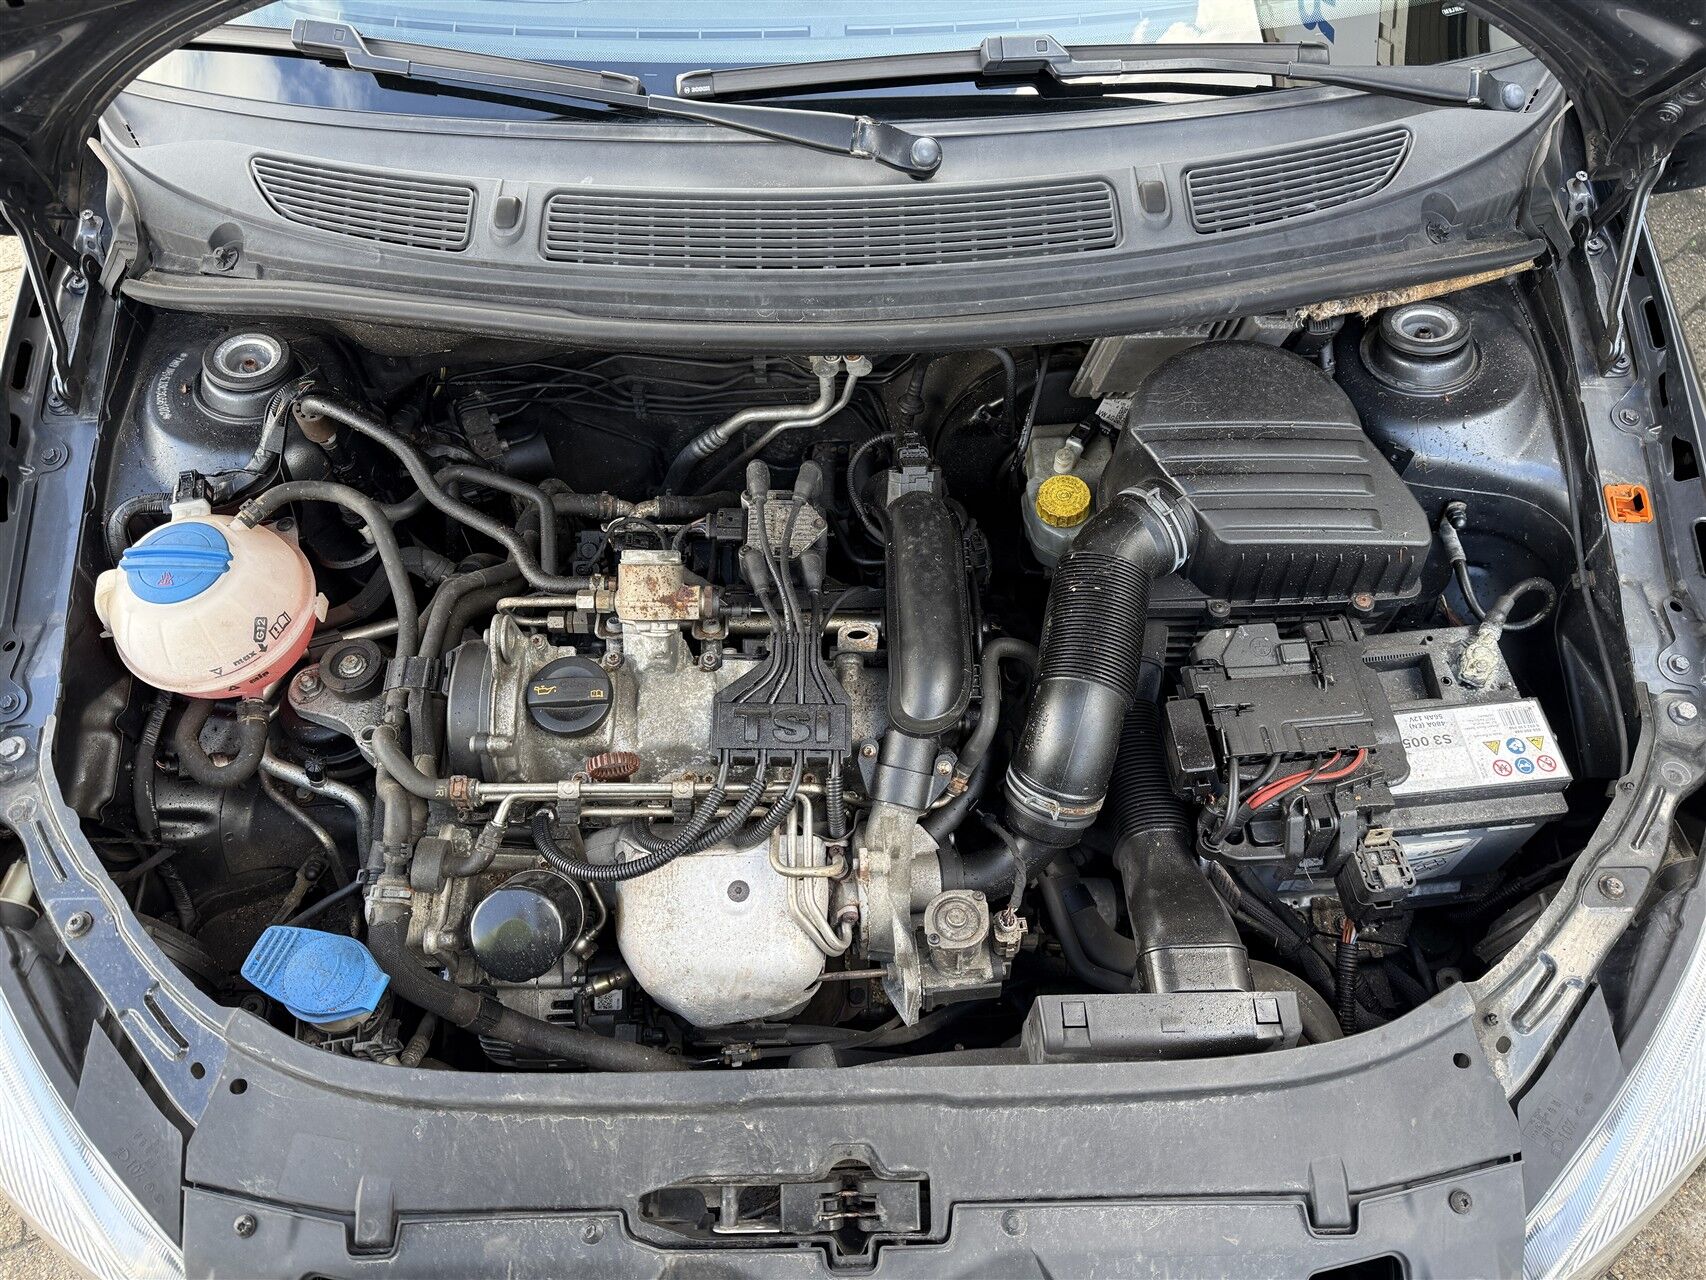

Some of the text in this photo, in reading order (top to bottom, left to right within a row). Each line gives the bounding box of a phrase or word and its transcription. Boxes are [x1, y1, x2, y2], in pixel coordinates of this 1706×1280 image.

[256, 619, 265, 640] G12
[233, 651, 257, 666] max
[249, 671, 269, 684] min
[734, 706, 831, 743] TSI
[1402, 734, 1452, 749] S3 005
